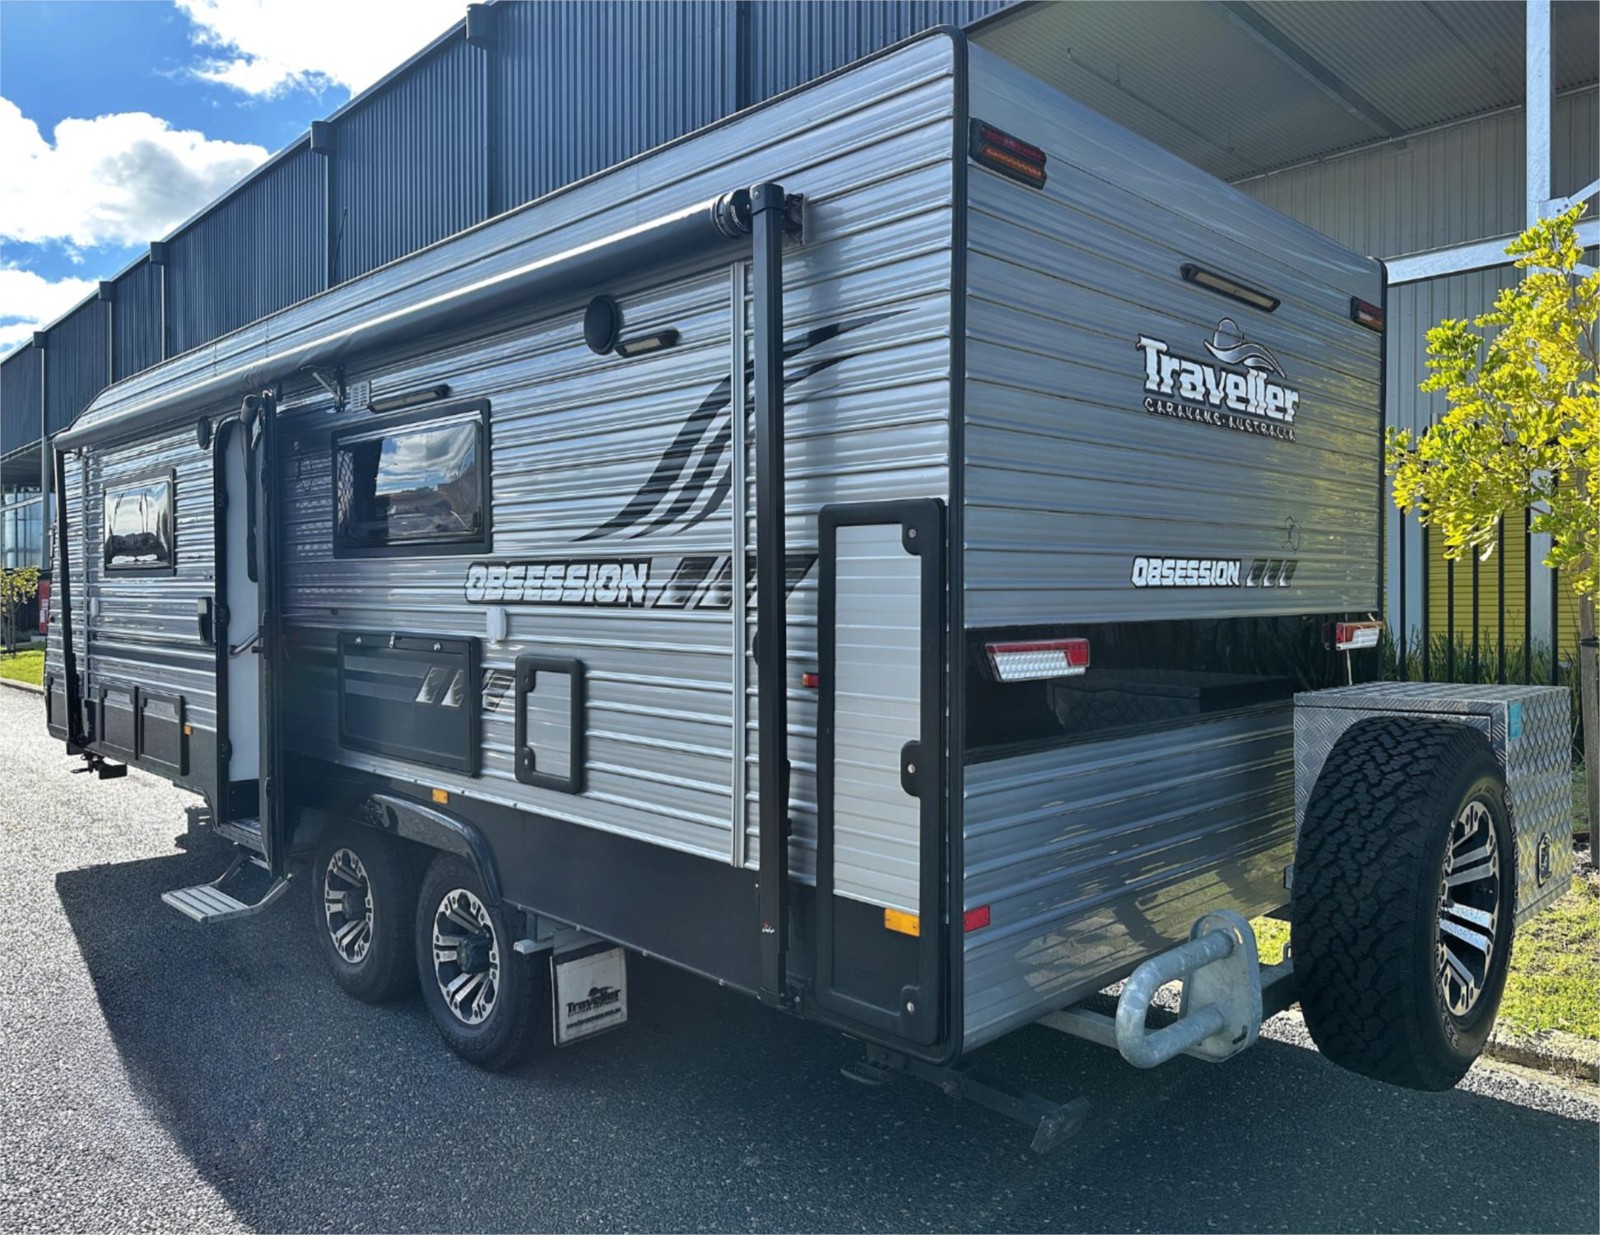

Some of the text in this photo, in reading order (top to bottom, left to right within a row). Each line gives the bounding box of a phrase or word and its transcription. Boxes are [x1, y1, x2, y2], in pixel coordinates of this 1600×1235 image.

[1136, 334, 1299, 423] Traveller
[1144, 397, 1296, 441] CARAVANS AUSTRALIA
[465, 558, 651, 607] OBSESSION
[1131, 556, 1241, 588] OBSESSION
